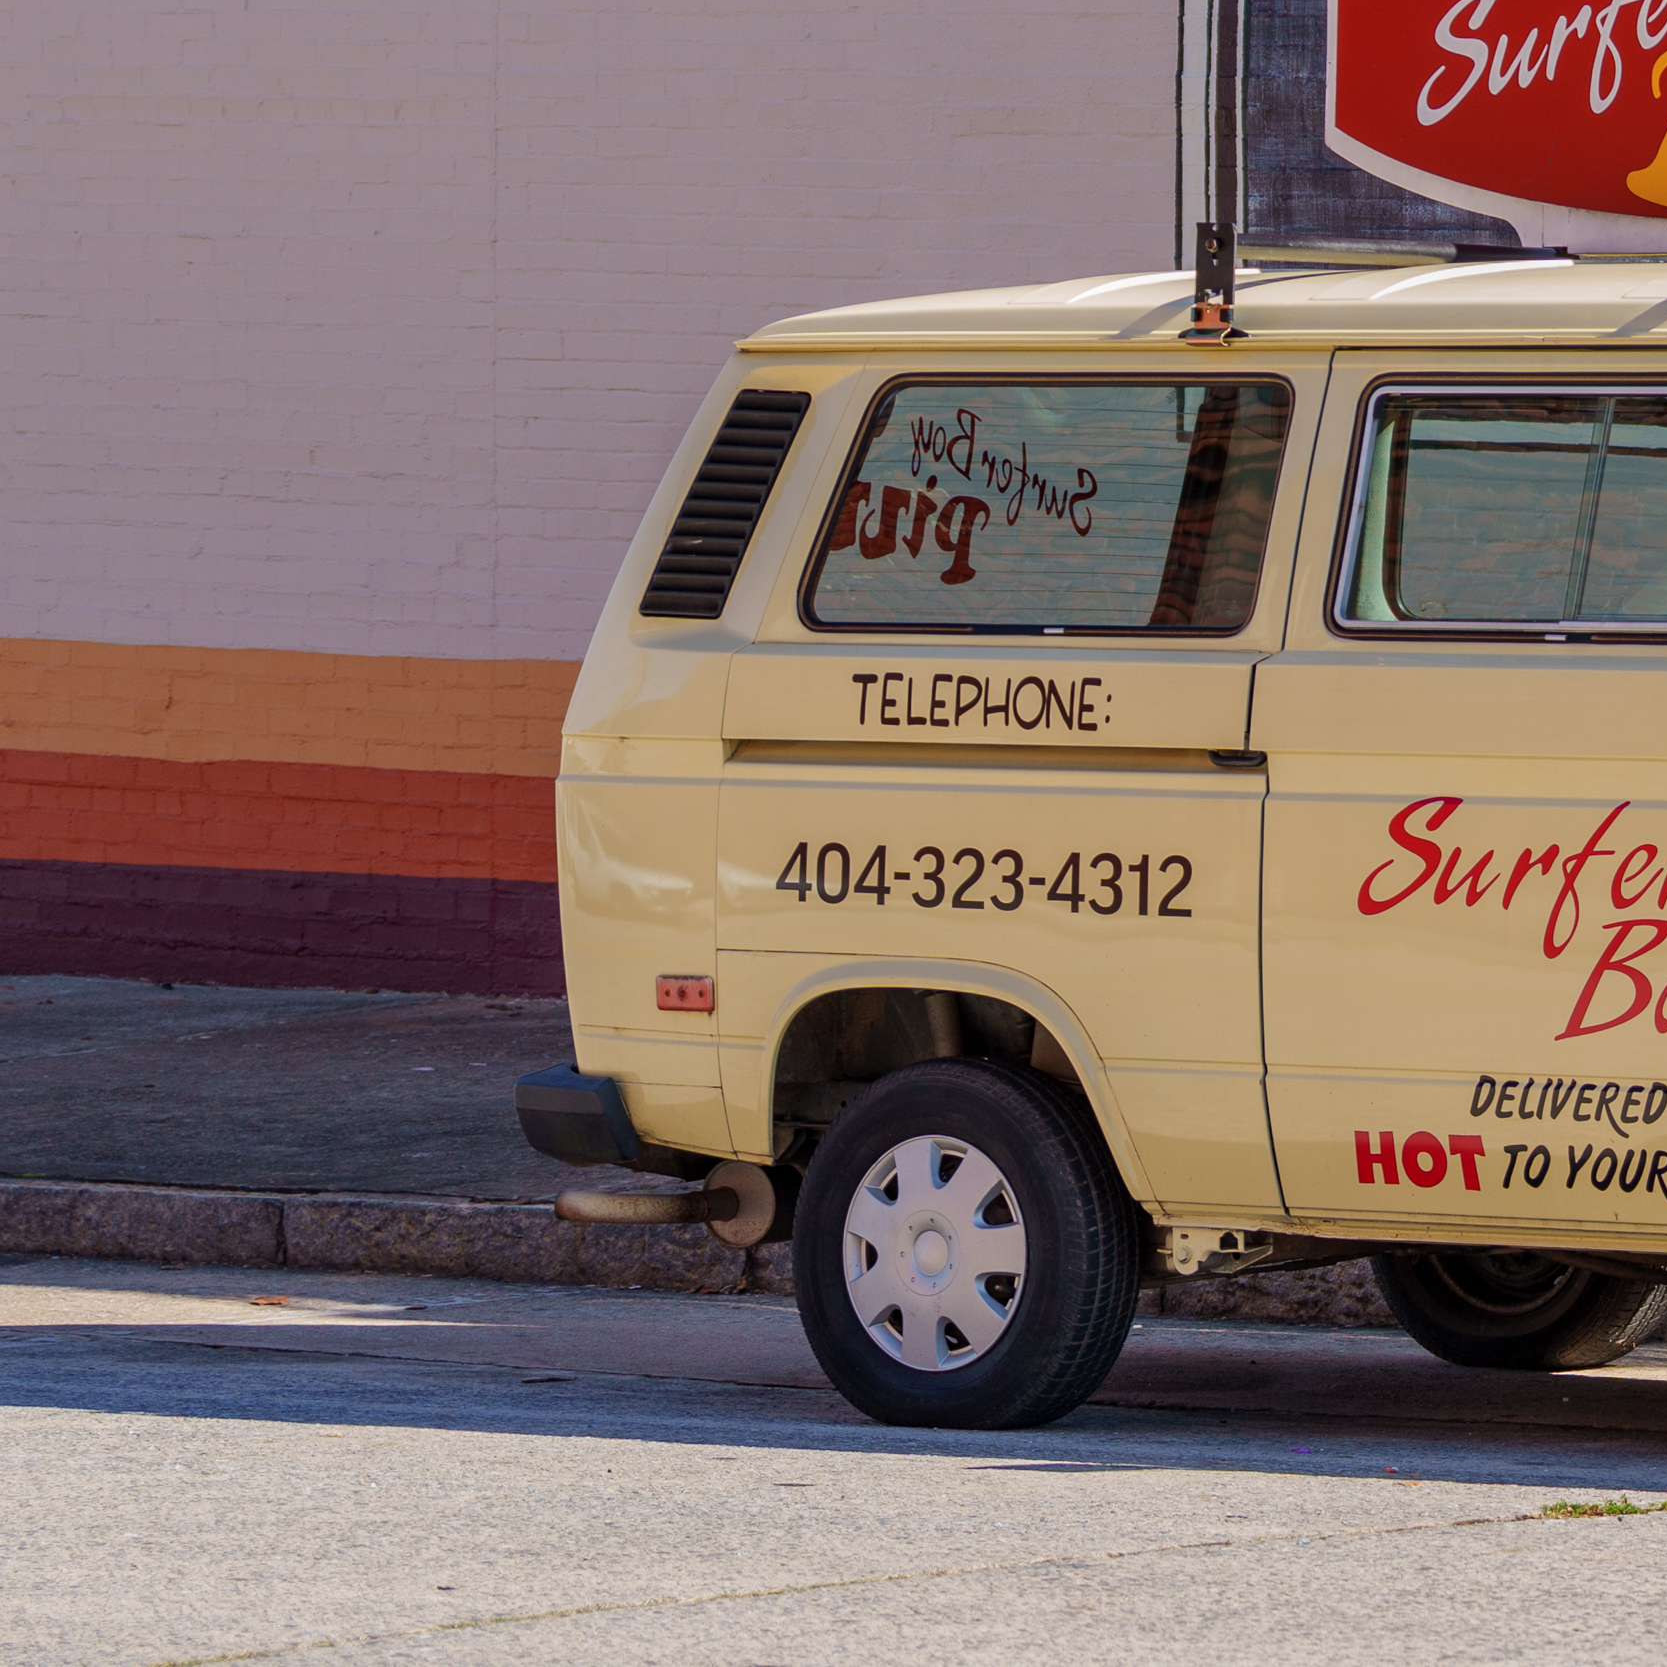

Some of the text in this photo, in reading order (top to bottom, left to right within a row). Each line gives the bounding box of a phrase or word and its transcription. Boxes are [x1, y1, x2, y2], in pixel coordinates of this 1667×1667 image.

[851, 672, 1113, 731] TELEPHONE:
[775, 841, 1194, 918] 404-323-4312
[1353, 1130, 1486, 1192] HOT
[1502, 1144, 1551, 1191] TO
